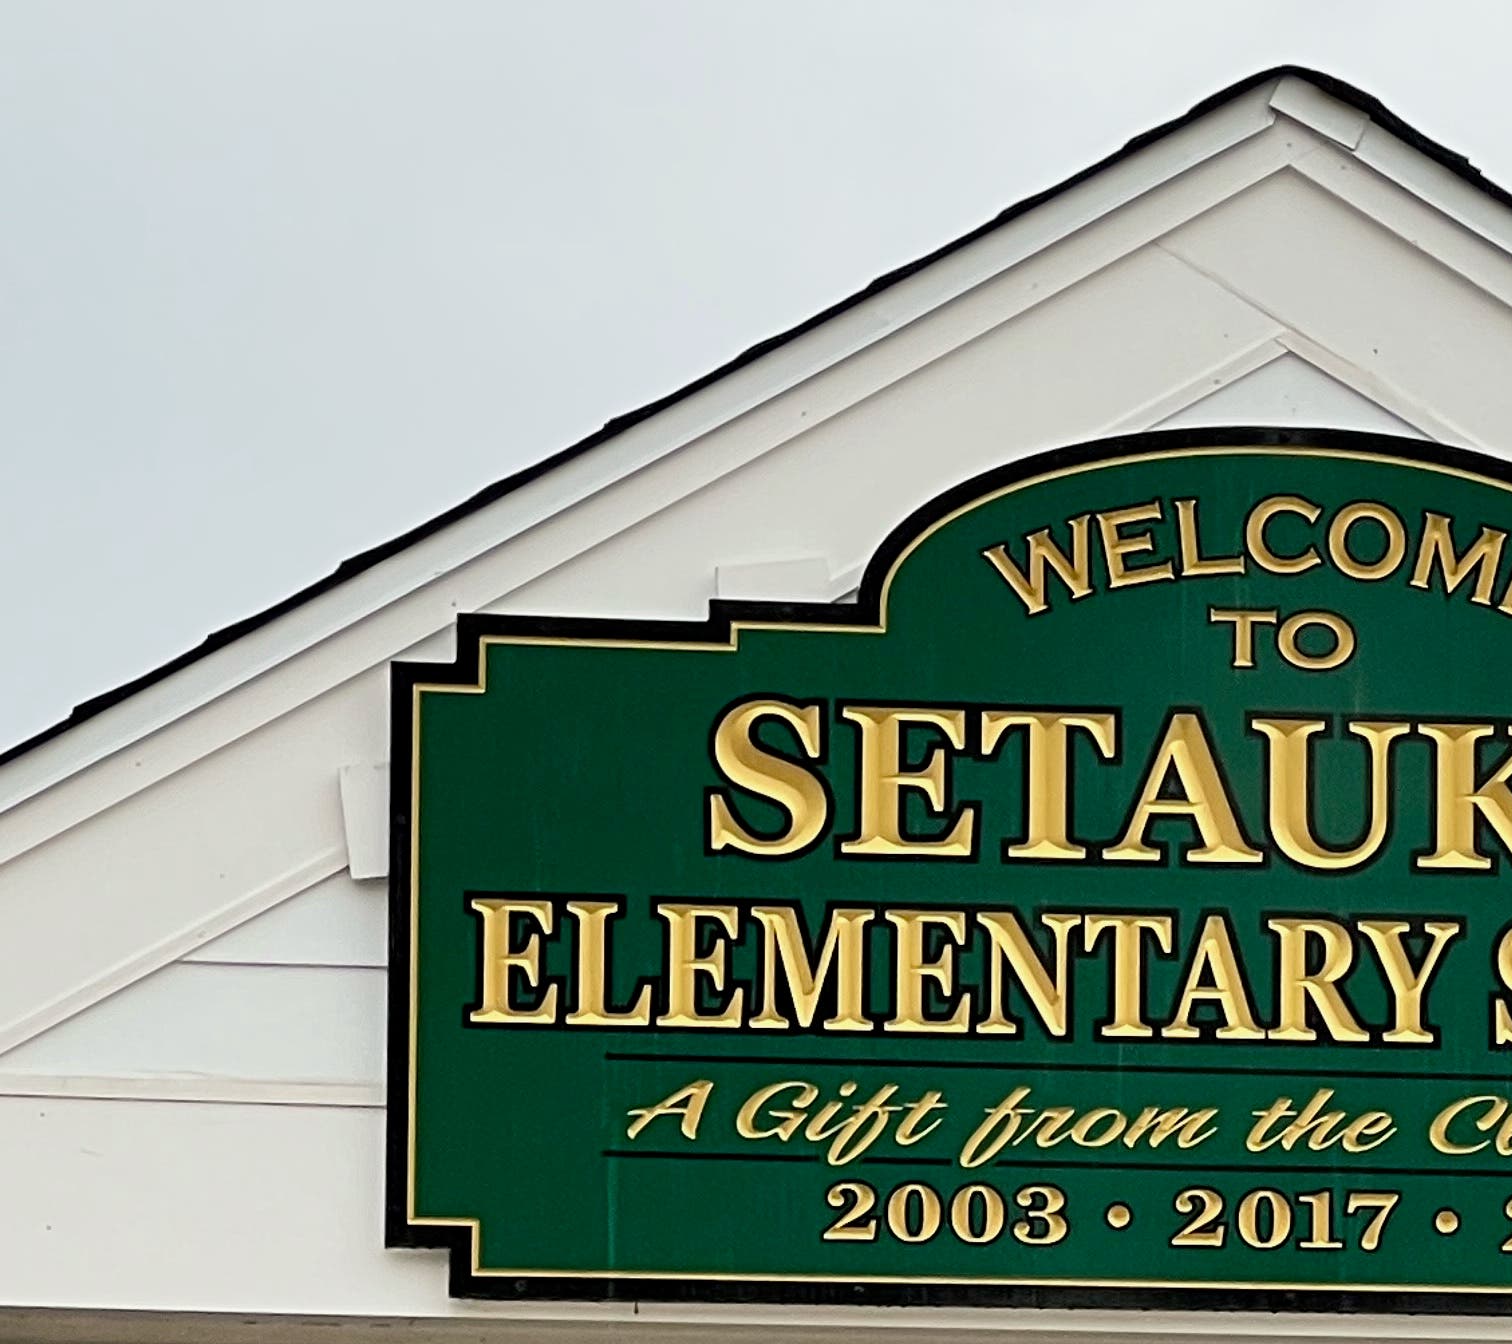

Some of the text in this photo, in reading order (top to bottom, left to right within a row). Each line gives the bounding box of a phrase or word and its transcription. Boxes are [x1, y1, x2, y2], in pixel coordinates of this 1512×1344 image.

[1208, 608, 1358, 671] TO
[467, 896, 1460, 1045] ELEMENTARY
[626, 1079, 717, 1140] A
[735, 1080, 951, 1167] Gift
[959, 1084, 1217, 1169] from
[1246, 1088, 1395, 1155] the
[820, 1182, 1069, 1247] 2003
[1170, 1186, 1399, 1251] 2017
